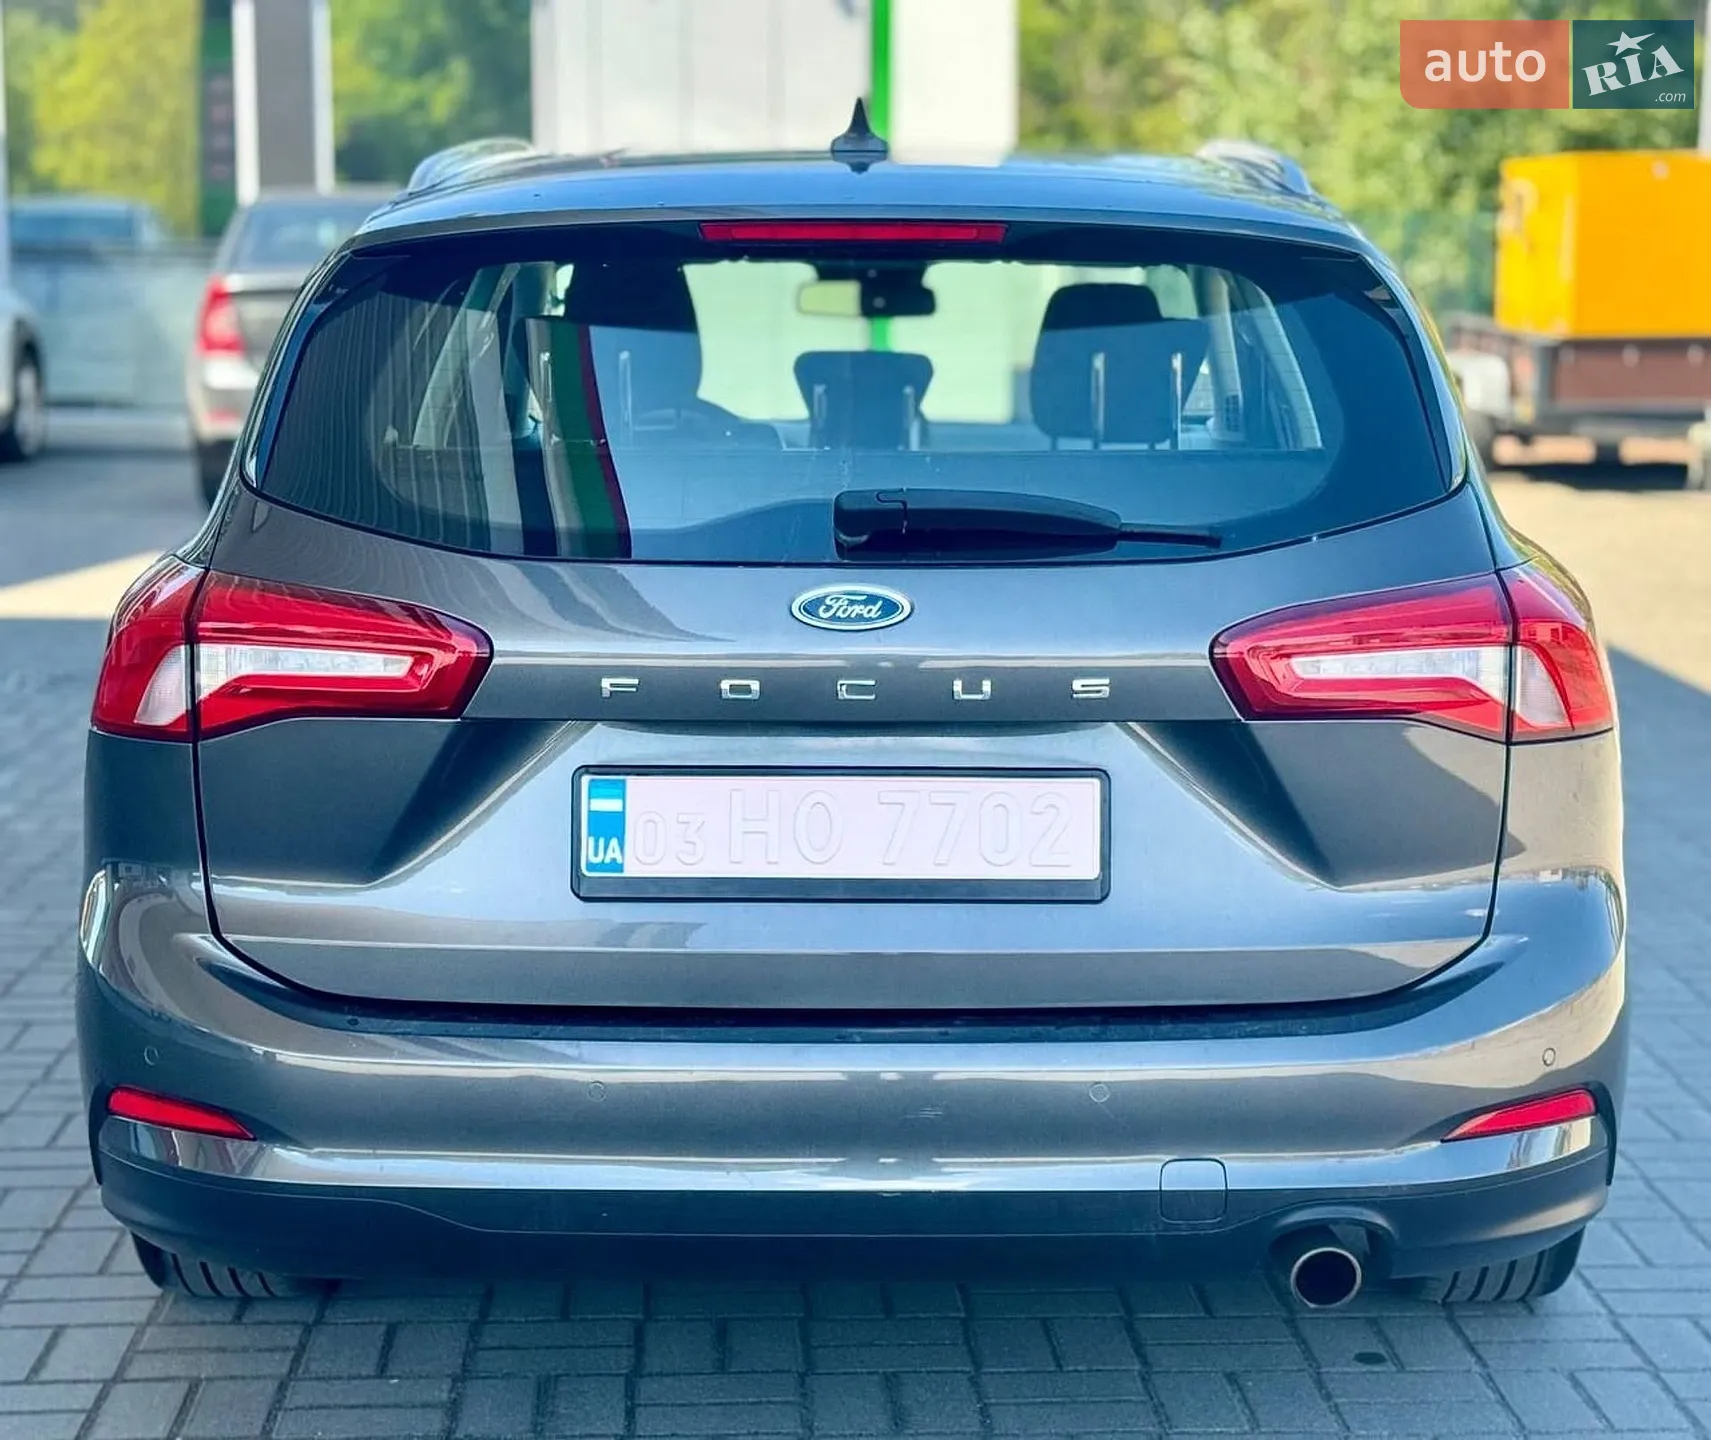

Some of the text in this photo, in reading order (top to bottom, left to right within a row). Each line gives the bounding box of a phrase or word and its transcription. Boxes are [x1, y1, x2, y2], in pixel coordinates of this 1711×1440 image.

[819, 594, 883, 619] Ford
[601, 676, 1111, 701] FOCUS
[633, 788, 1073, 868] 03 HO 7702
[588, 836, 623, 864] UA
